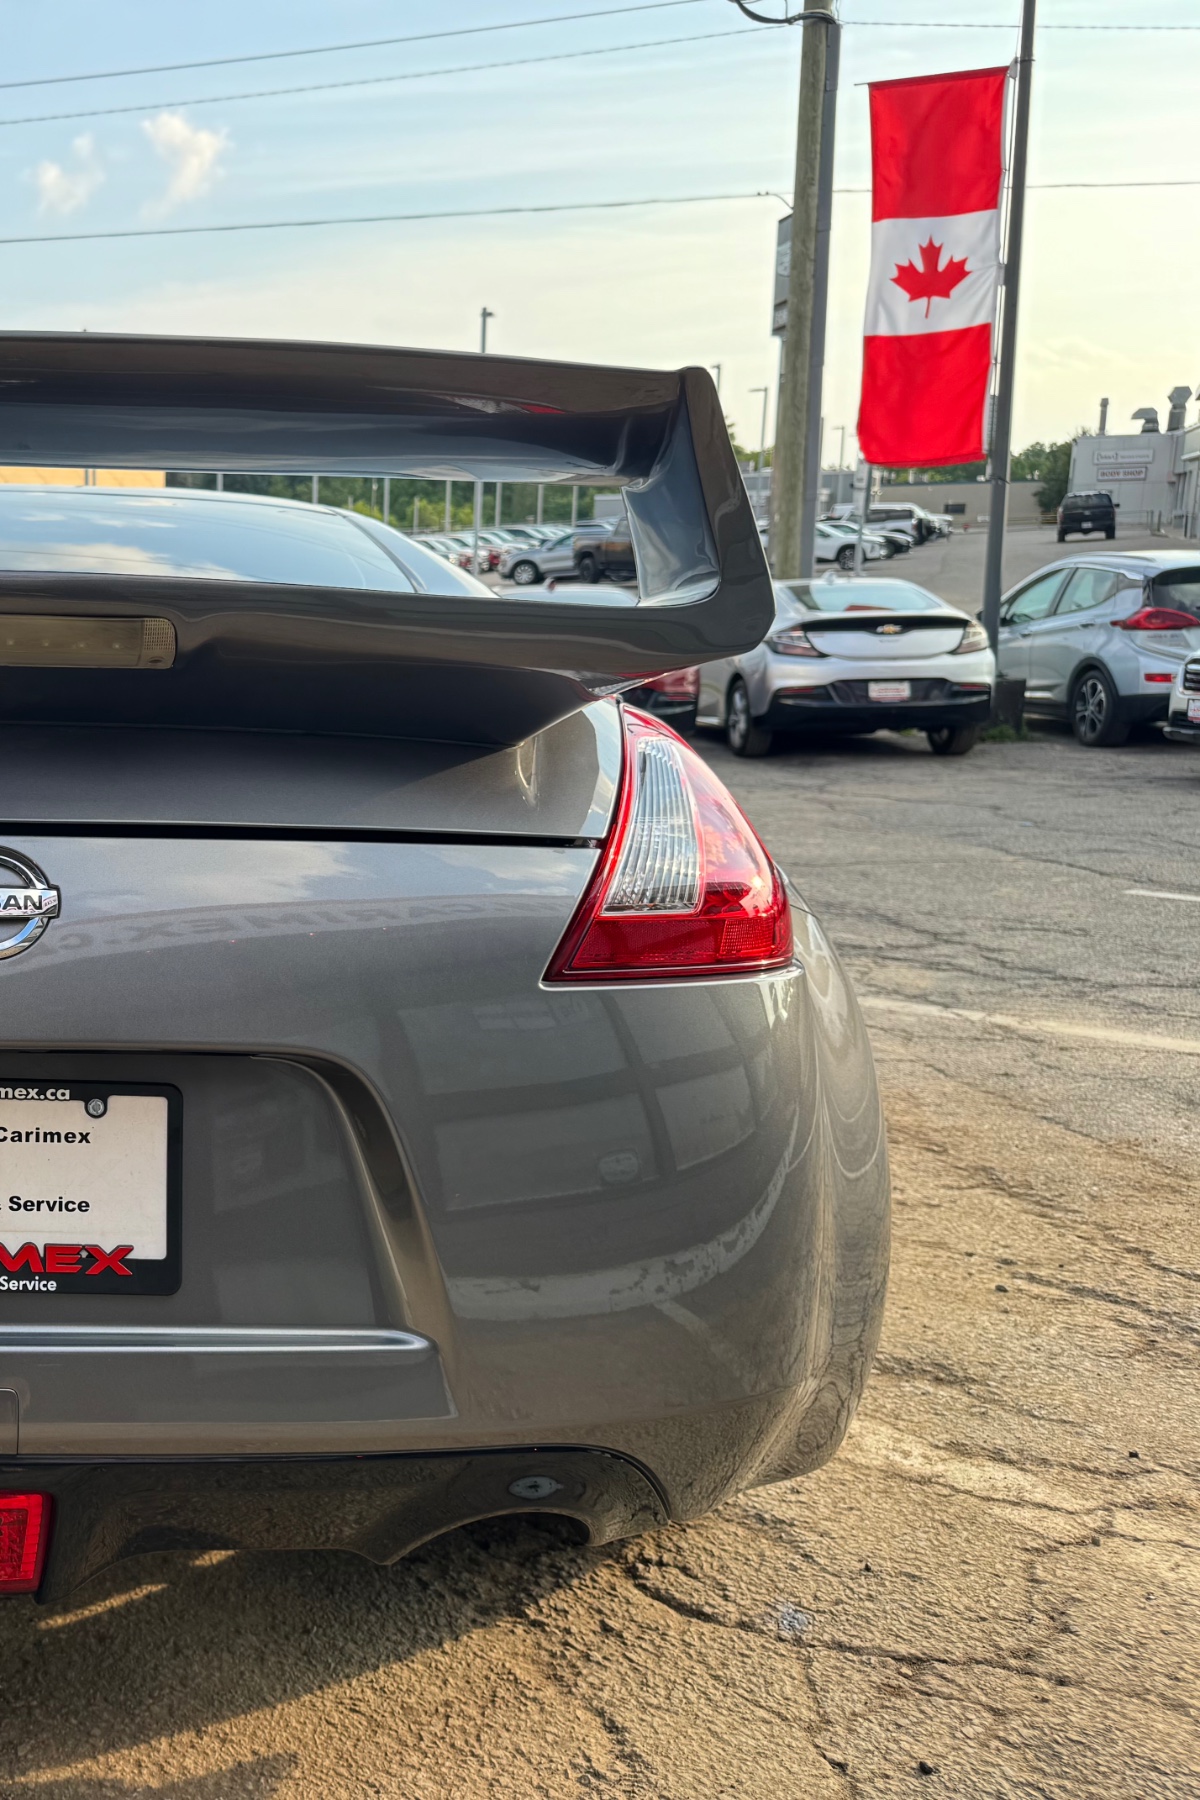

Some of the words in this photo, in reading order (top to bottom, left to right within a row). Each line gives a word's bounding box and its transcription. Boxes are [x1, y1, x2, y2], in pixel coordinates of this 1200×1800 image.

[1122, 469, 1144, 477] SHOP
[8, 1195, 91, 1213] Service
[0, 1275, 57, 1292] Service
